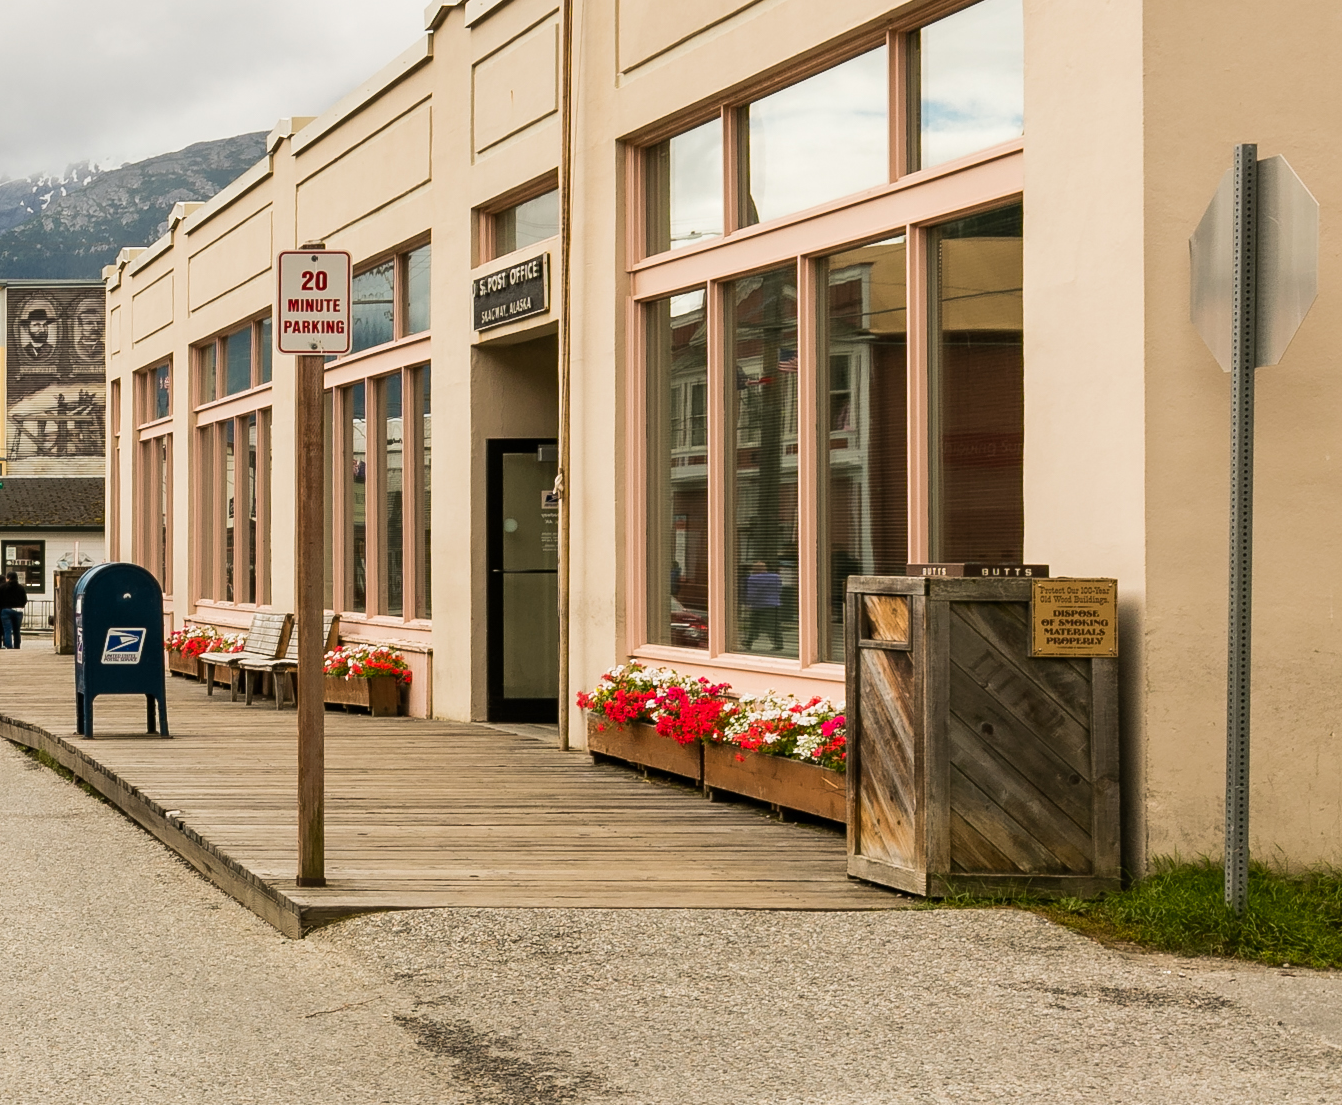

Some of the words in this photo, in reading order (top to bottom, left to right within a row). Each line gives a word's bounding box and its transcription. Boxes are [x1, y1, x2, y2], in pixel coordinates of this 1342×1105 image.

[301, 271, 328, 291] 20
[488, 272, 506, 293] POST
[510, 261, 539, 285] OFFICE
[288, 299, 341, 312] MINUTE
[510, 297, 531, 314] ALASKA
[284, 320, 345, 334] PARKING
[922, 567, 946, 575] BUTTS
[981, 568, 1033, 576] BUTTS
[1039, 586, 1065, 595] Protect
[1074, 596, 1109, 605] Buildings.
[1044, 628, 1105, 636] MATERIALS
[1046, 637, 1103, 645] PROPERLY
